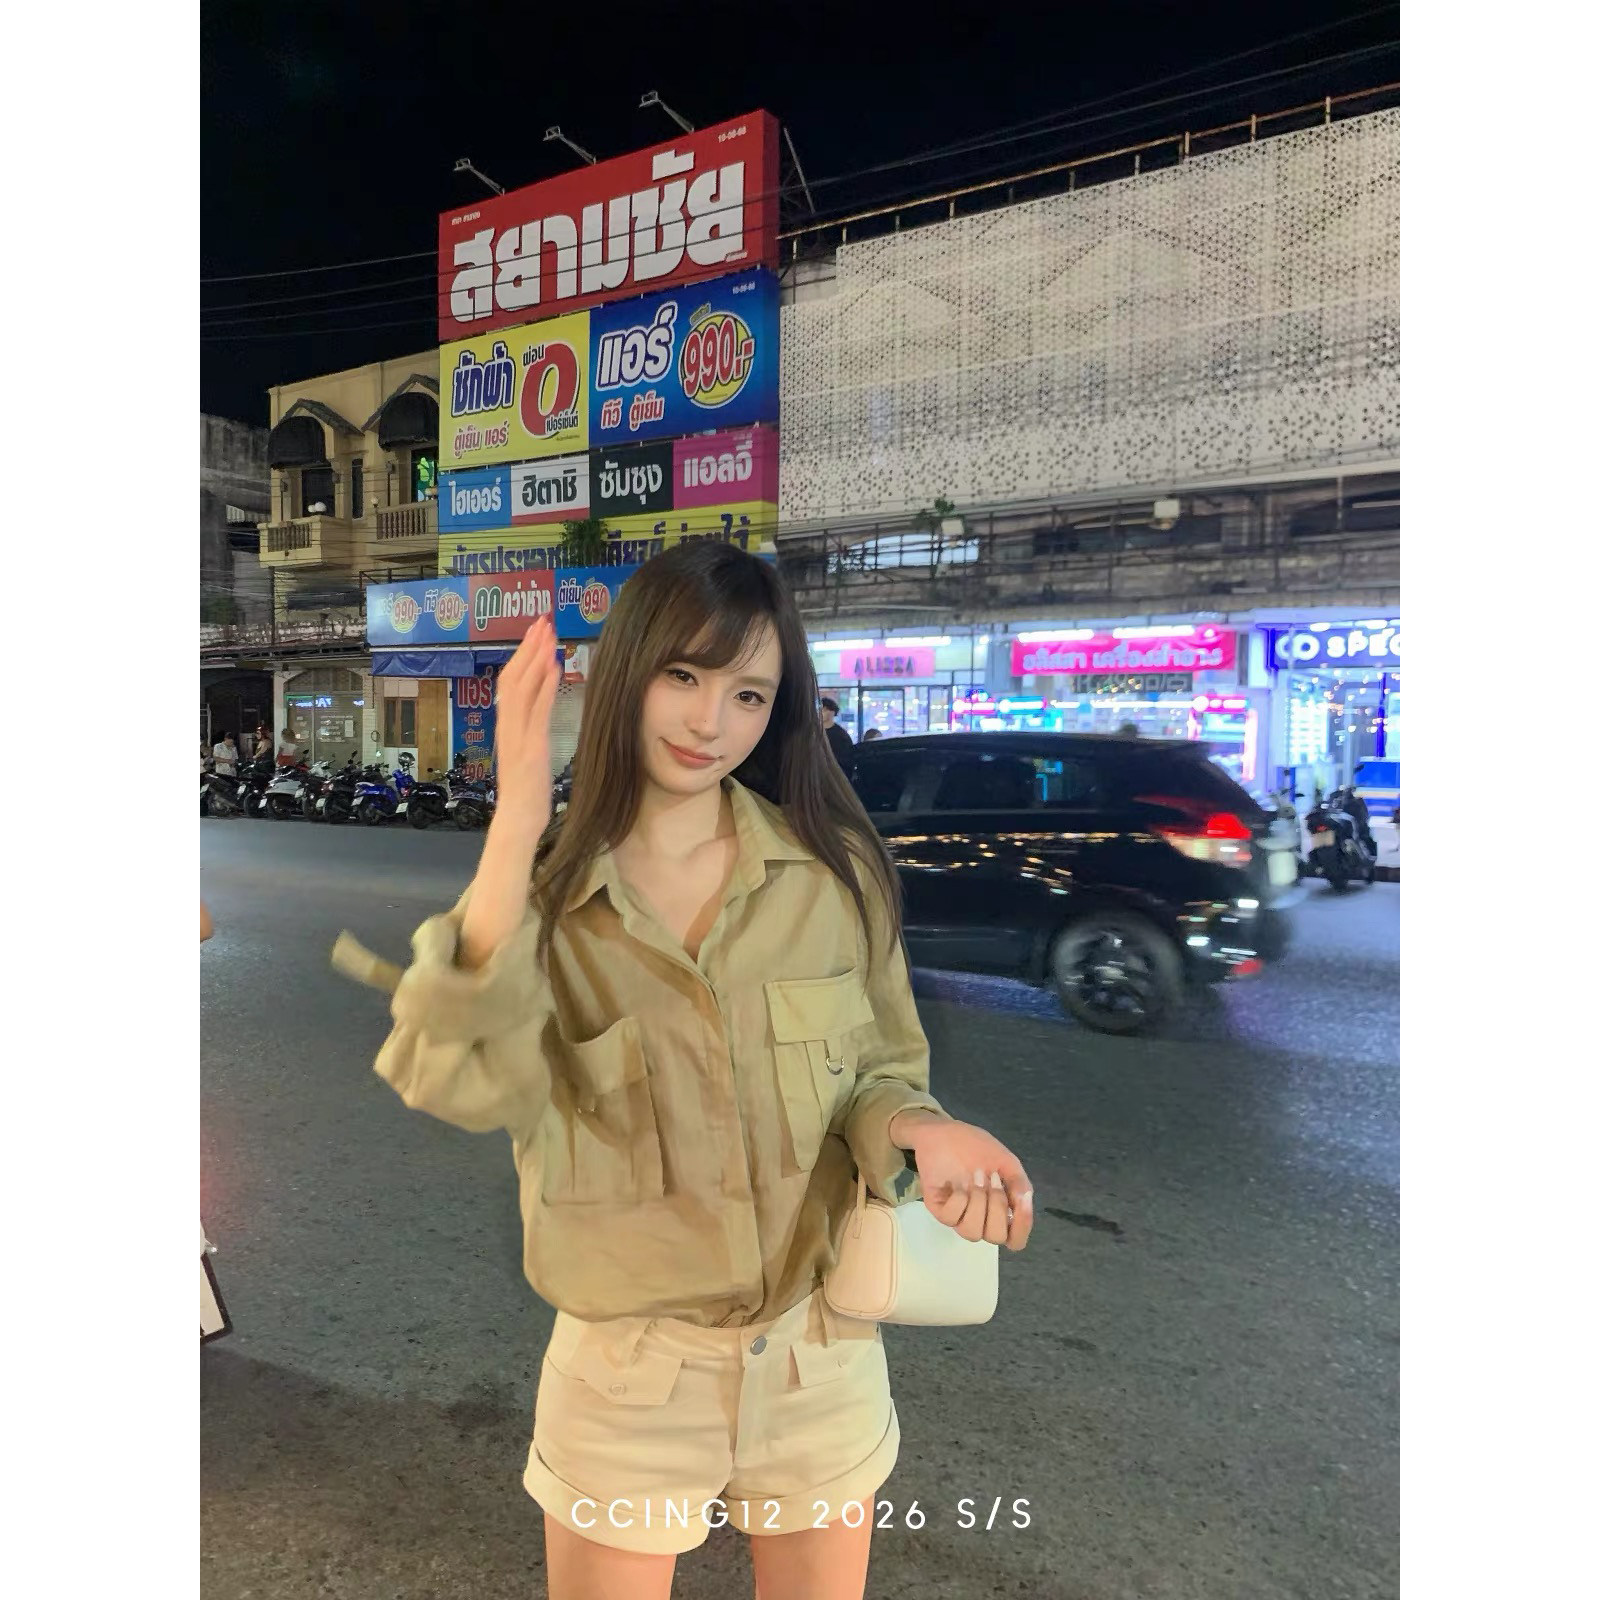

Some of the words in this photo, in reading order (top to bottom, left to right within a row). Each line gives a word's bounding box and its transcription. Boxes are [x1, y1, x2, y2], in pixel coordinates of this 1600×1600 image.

[450, 150, 745, 323] สยามชัย
[523, 344, 545, 367] ผ่อน
[597, 303, 677, 390] แอร์
[452, 341, 516, 417] ซักผ้า
[520, 341, 580, 439] 0
[601, 398, 622, 429] ทีวี
[630, 390, 665, 432] ตู้เย็น
[454, 424, 481, 458] ตู้เย็น
[484, 420, 509, 448] แอร์
[599, 461, 663, 505] ซัมซุง
[683, 441, 753, 488] แอลจี
[448, 477, 502, 517] ไฮเออร์
[522, 468, 578, 507] ฮิตาชิ
[558, 577, 583, 612] ตู้เย็น
[457, 664, 493, 709] แอร์
